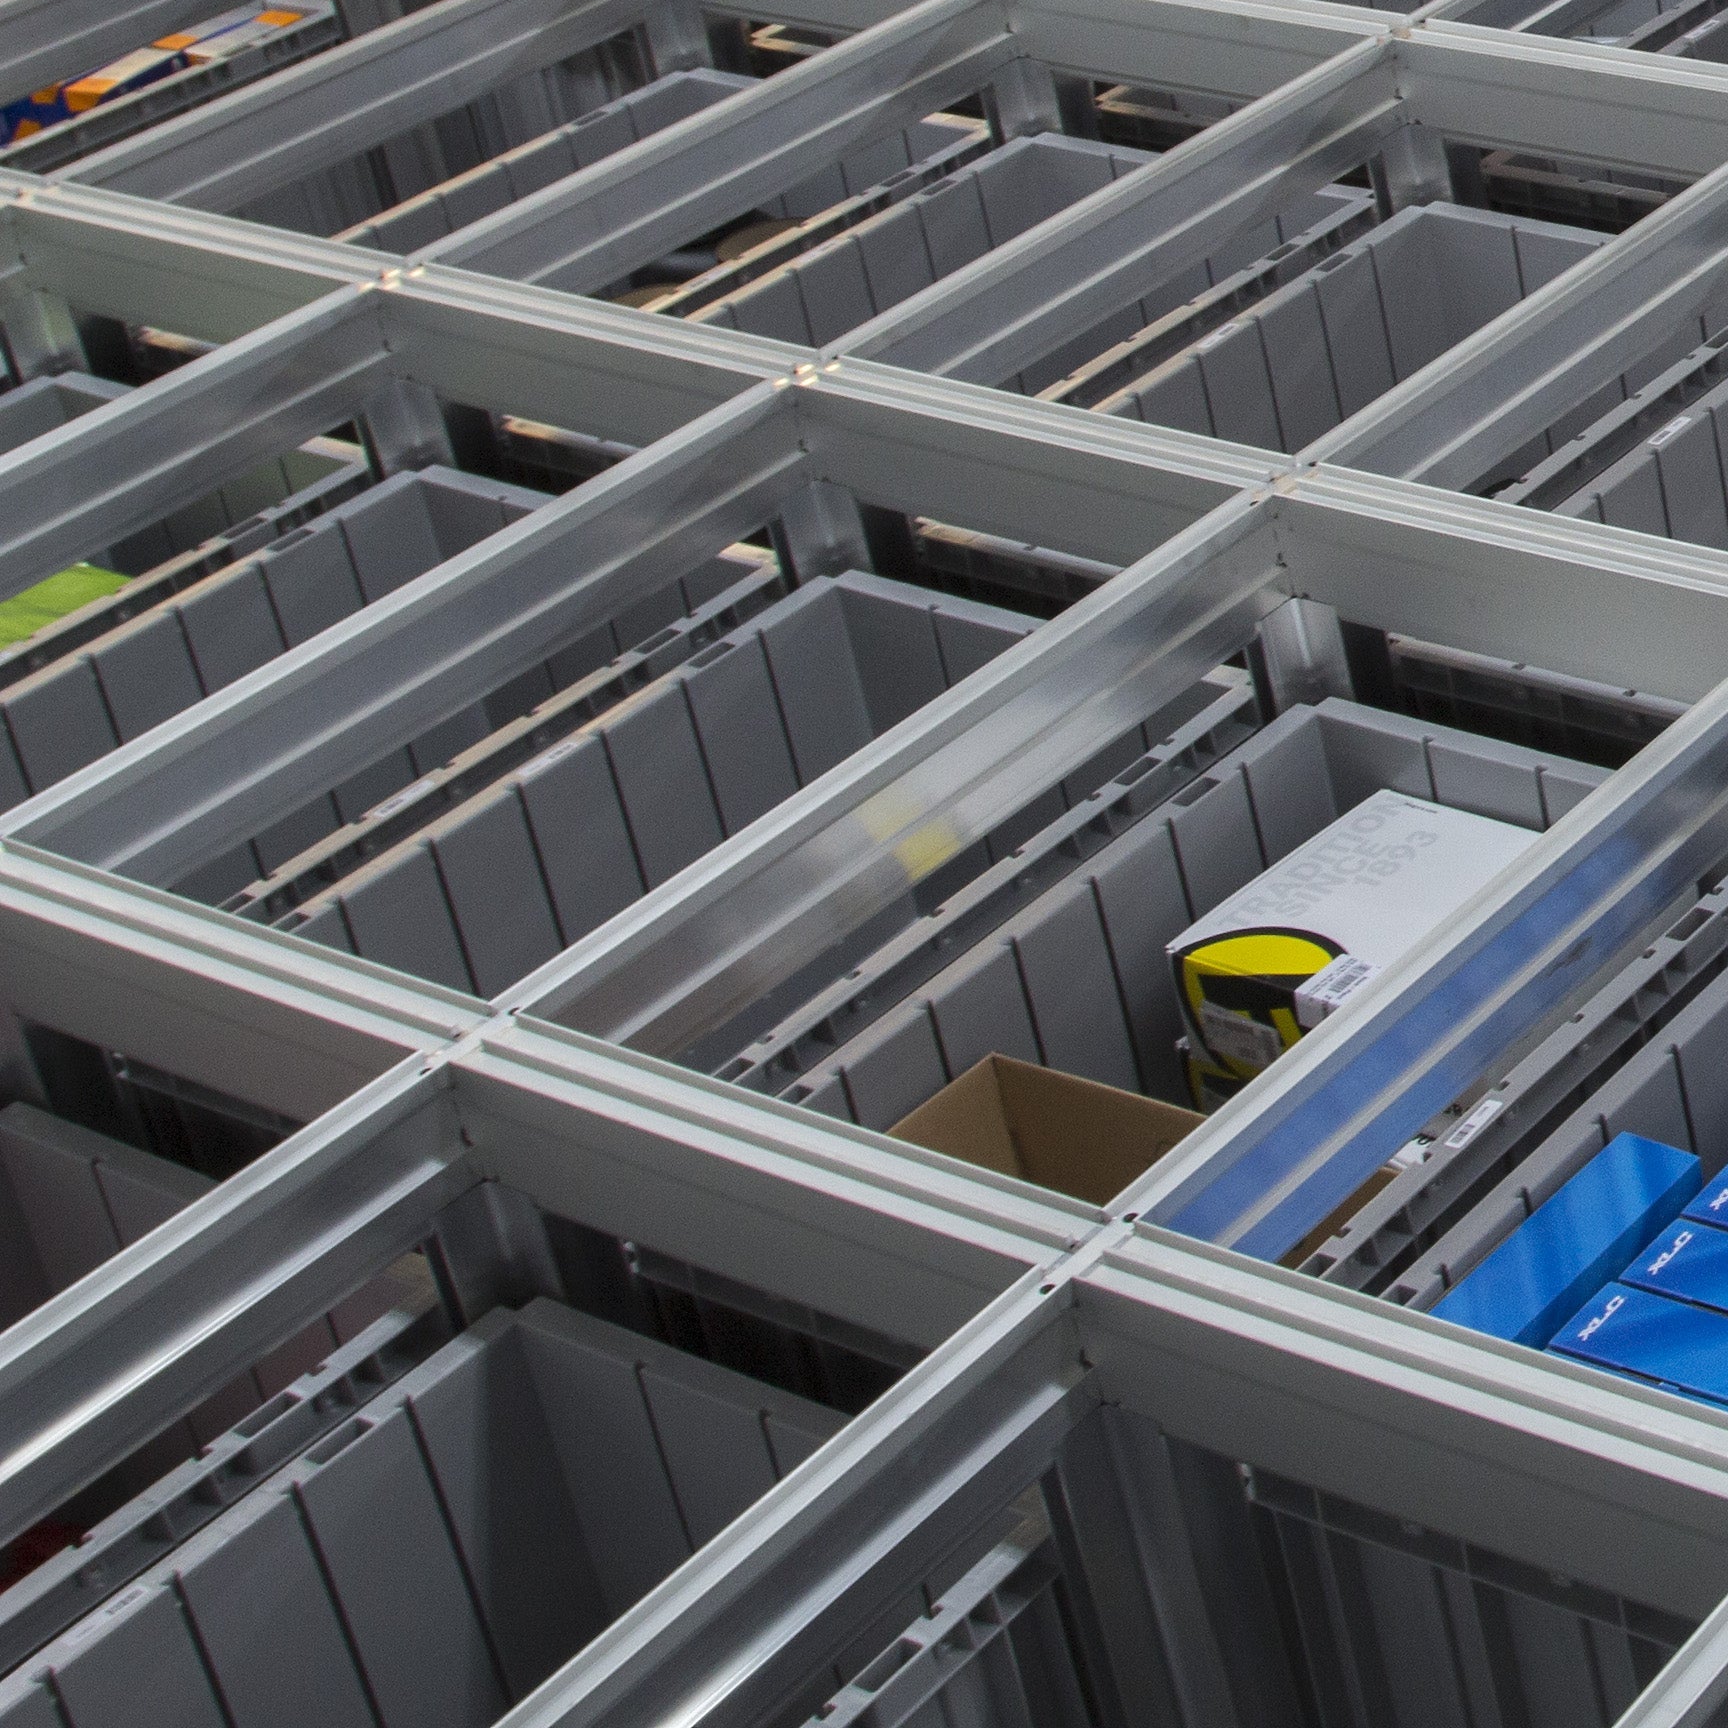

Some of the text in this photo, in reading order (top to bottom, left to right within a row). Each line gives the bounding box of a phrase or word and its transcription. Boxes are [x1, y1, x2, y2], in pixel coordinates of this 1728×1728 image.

[1217, 794, 1406, 925] TRADITION
[1275, 842, 1391, 918] SINCE
[1353, 830, 1440, 887] 1893
[1646, 1231, 1694, 1275] XLC
[1576, 1294, 1626, 1342] XLC
